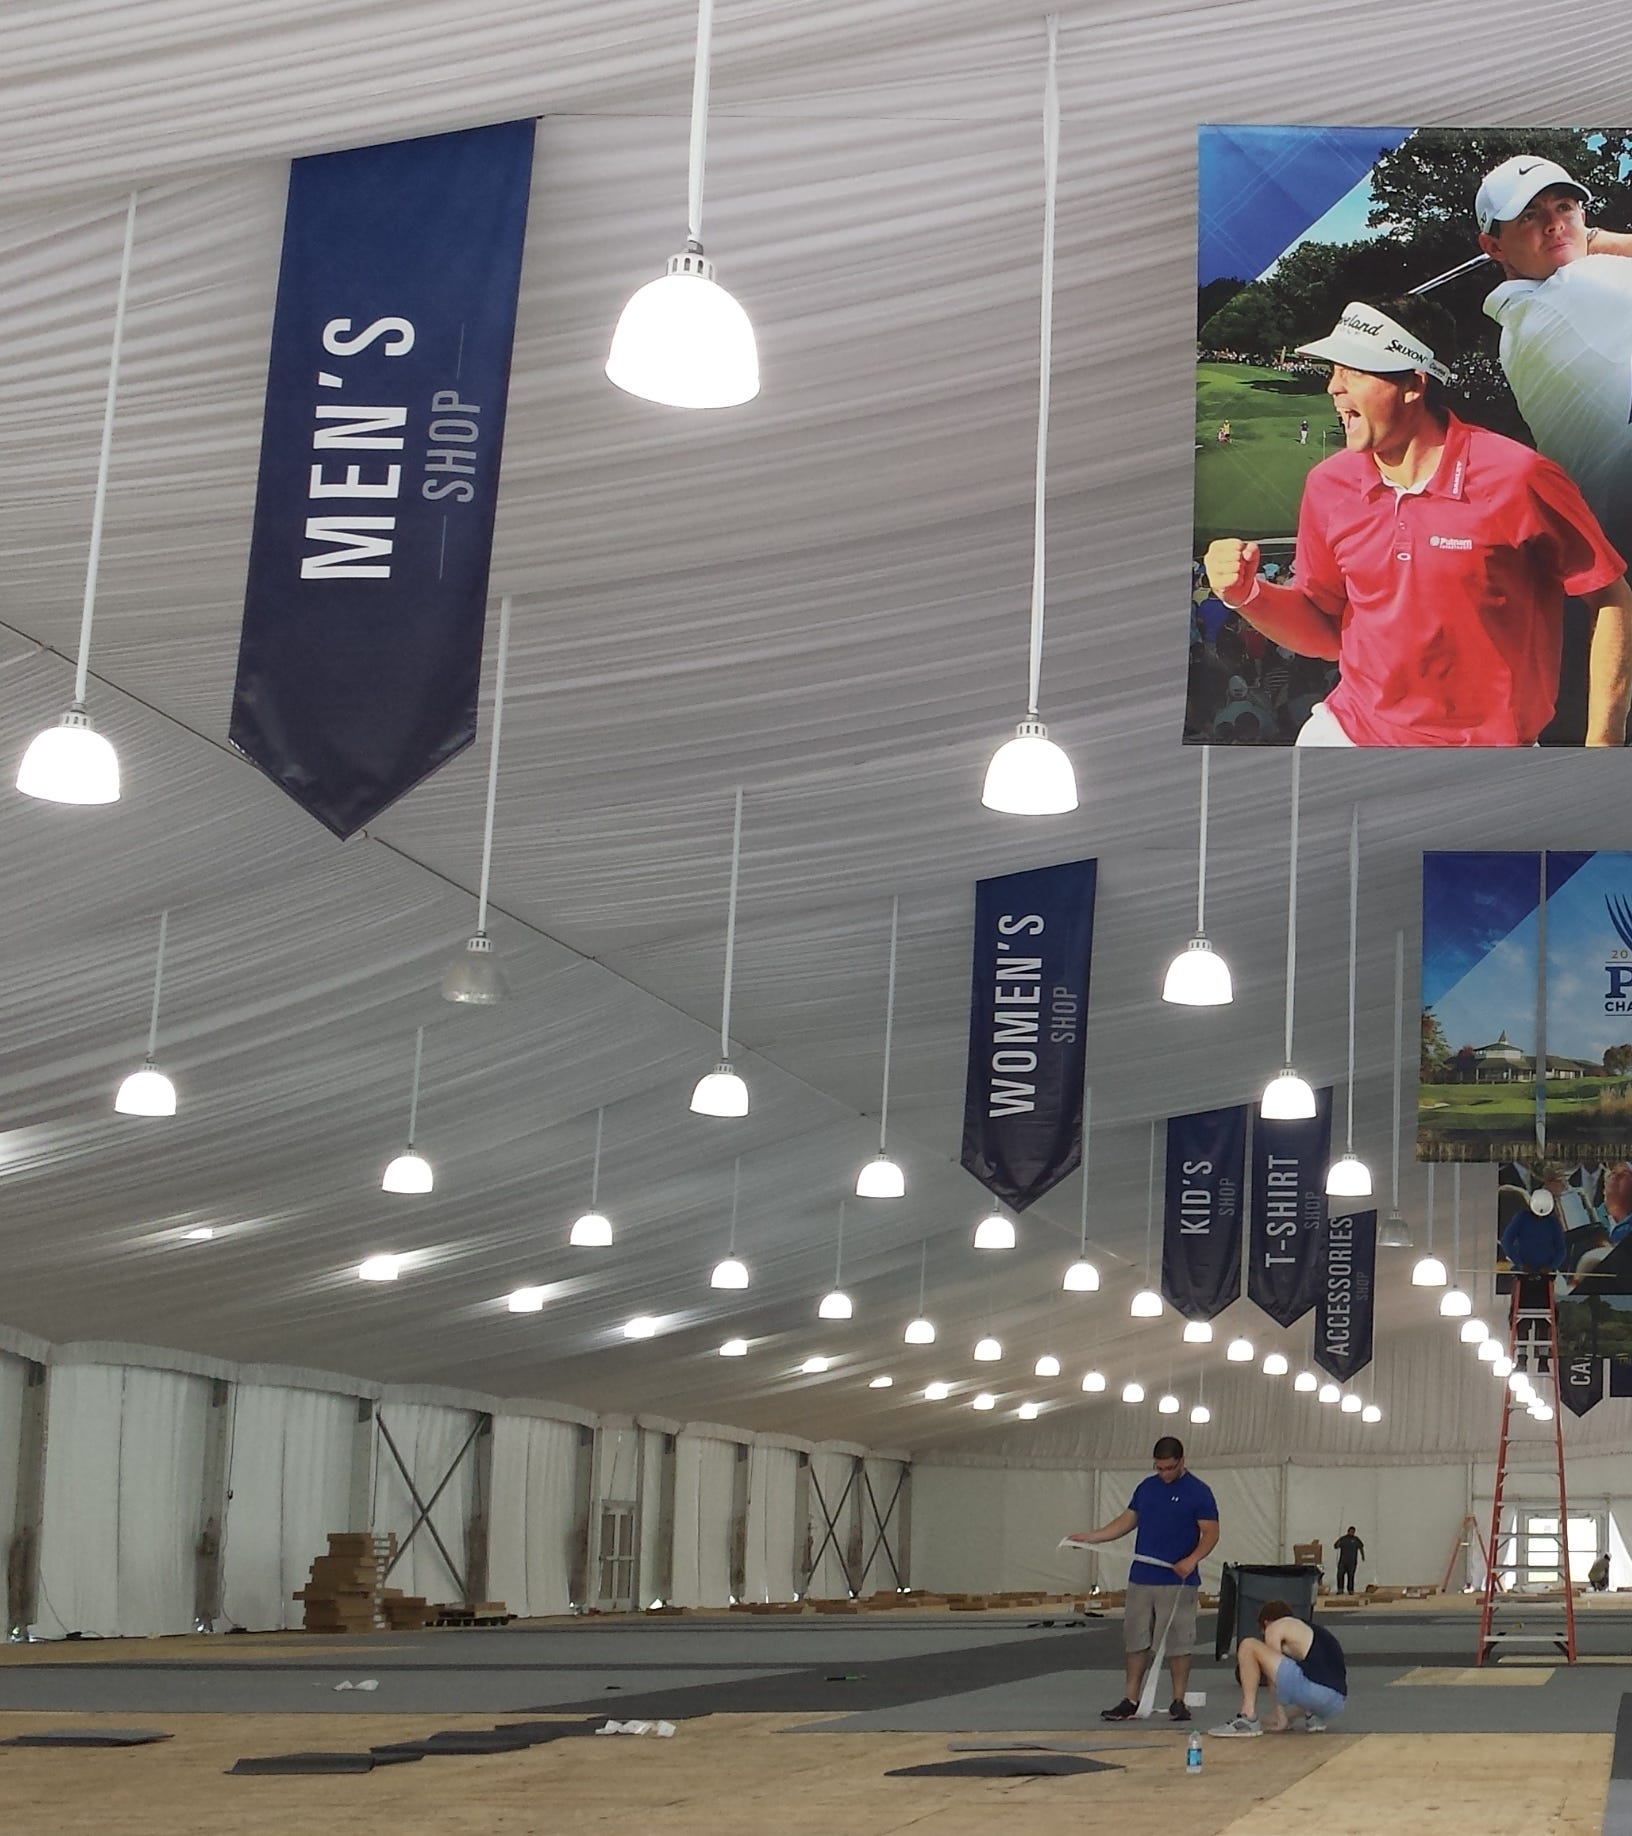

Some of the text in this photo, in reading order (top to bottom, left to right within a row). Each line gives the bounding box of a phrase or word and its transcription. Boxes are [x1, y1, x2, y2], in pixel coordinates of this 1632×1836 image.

[300, 316, 415, 580] MEN'S
[422, 389, 482, 504] SHOP
[1611, 950, 1628, 959] 20
[989, 914, 1045, 1118] WOMEN'S
[1051, 986, 1078, 1044] SHOP
[1180, 1160, 1212, 1235] KID'S
[1218, 1177, 1236, 1217] SHOP
[1265, 1155, 1299, 1268] T-SHIRT
[1304, 1191, 1321, 1230] SHOP
[1326, 1217, 1353, 1356] ACCESSORIES
[1569, 1357, 1591, 1386] CA
